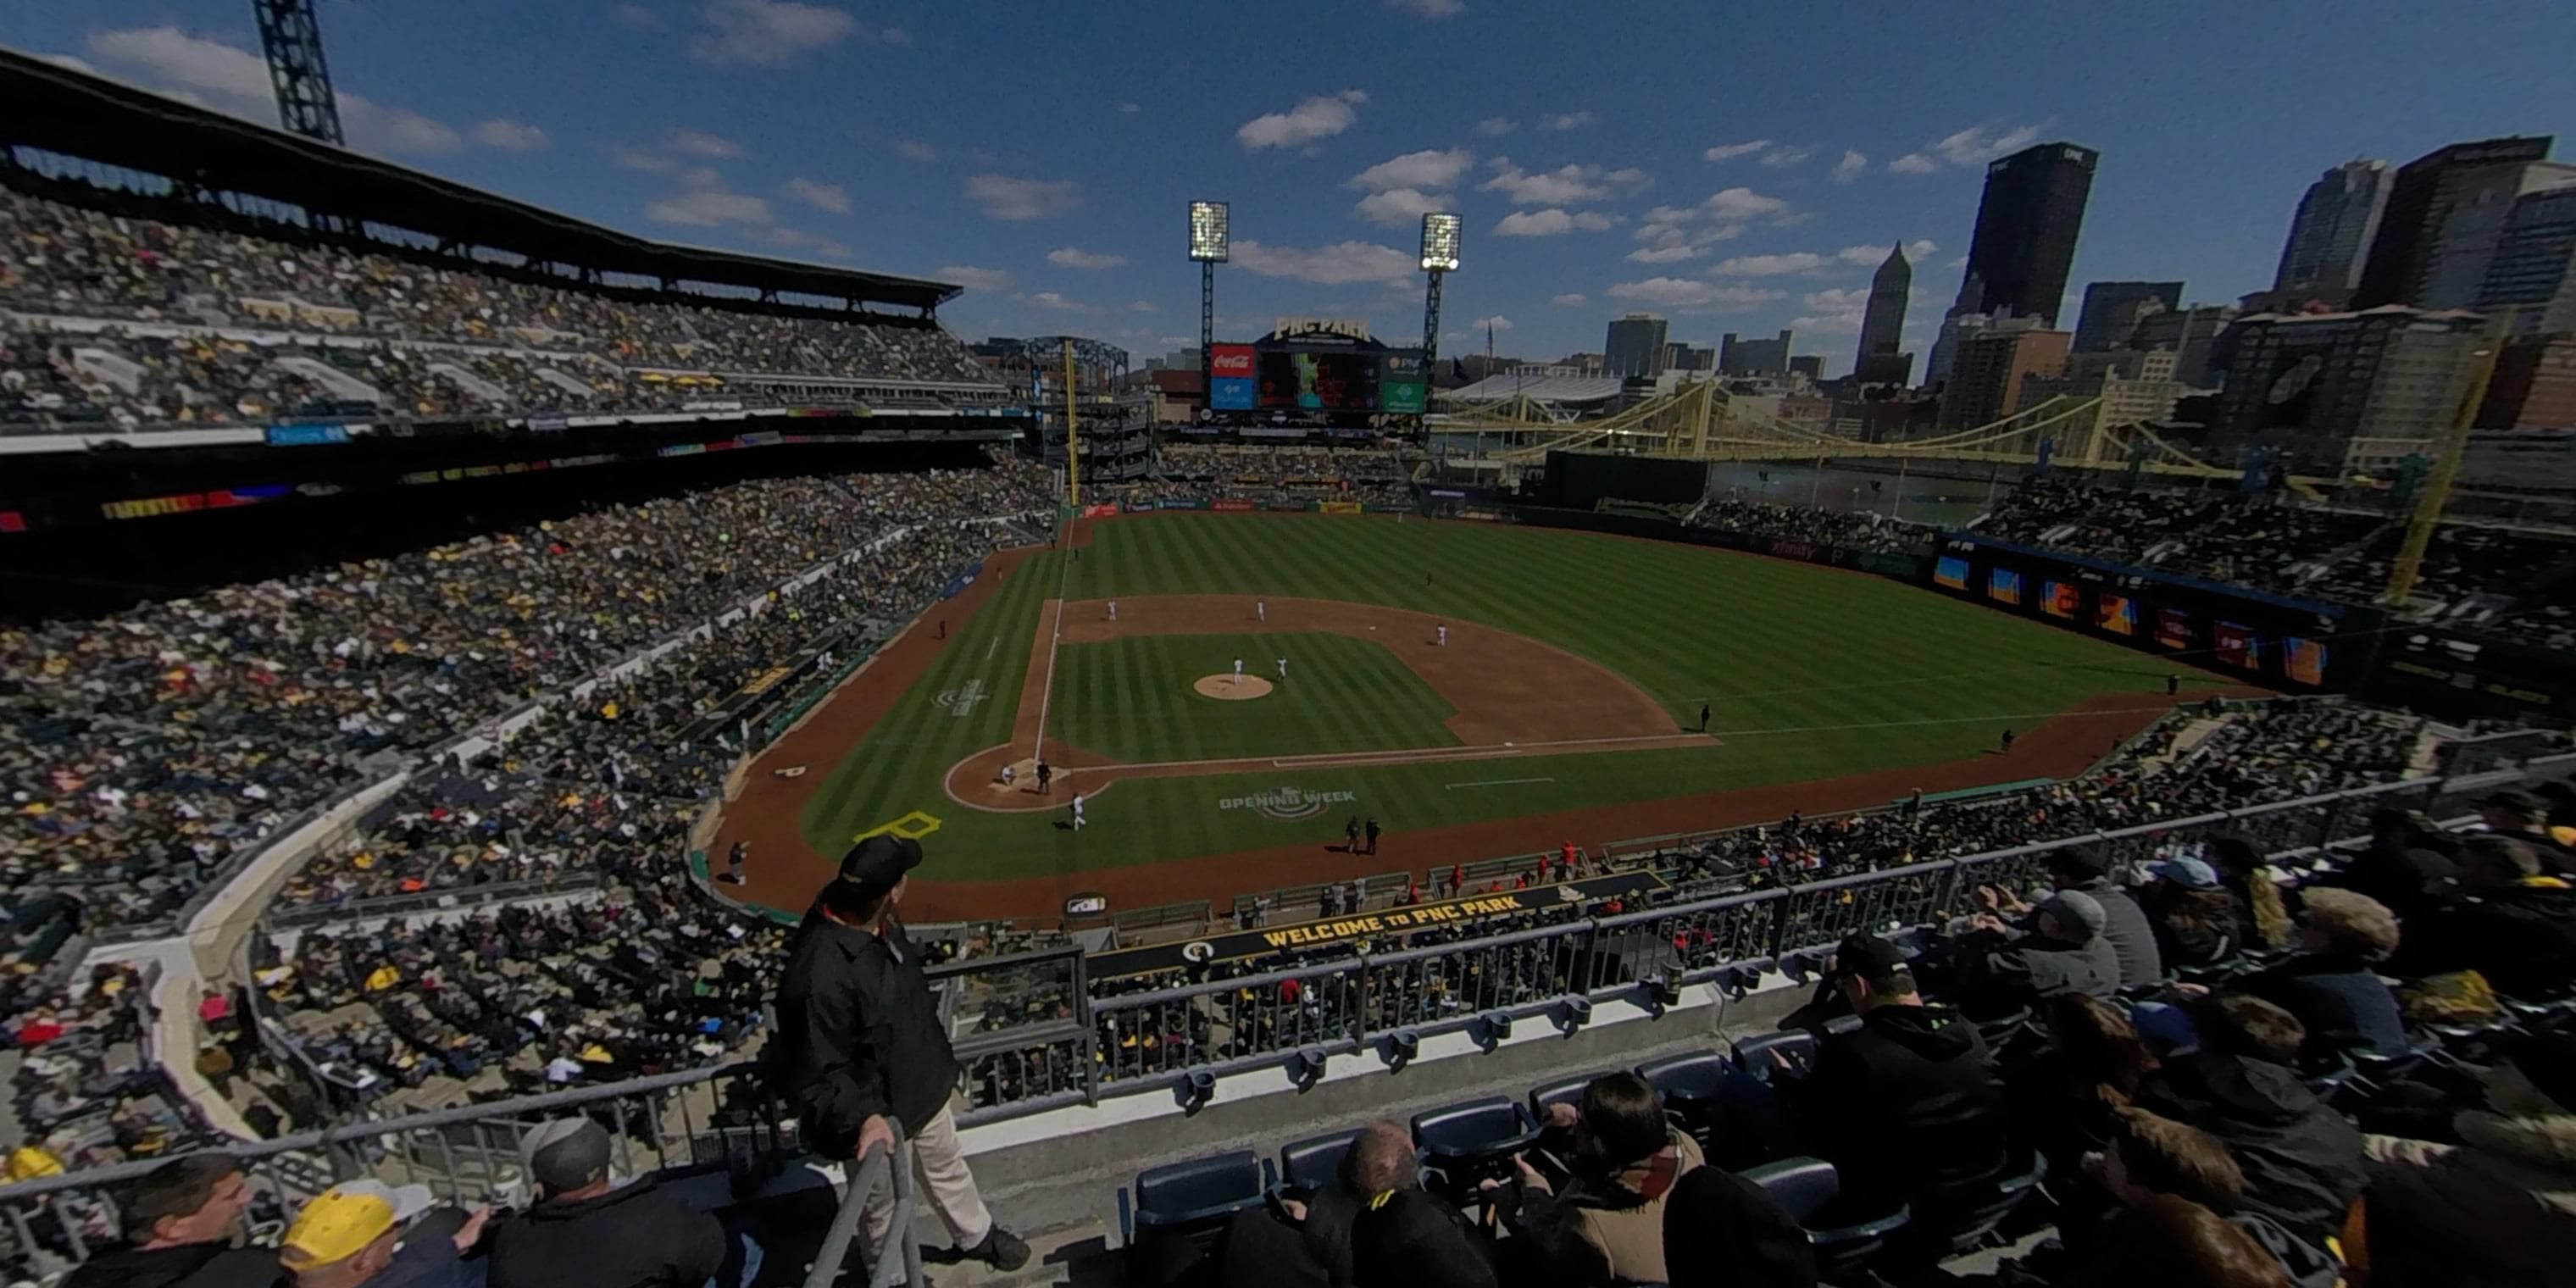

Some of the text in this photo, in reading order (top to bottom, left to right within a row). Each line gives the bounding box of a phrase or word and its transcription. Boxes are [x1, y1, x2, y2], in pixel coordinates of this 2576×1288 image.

[1274, 319, 1371, 343] PNC PARK
[1219, 790, 1357, 809] OPENING WEEK
[1263, 895, 1524, 948] WELCOME TO PNC PARK
